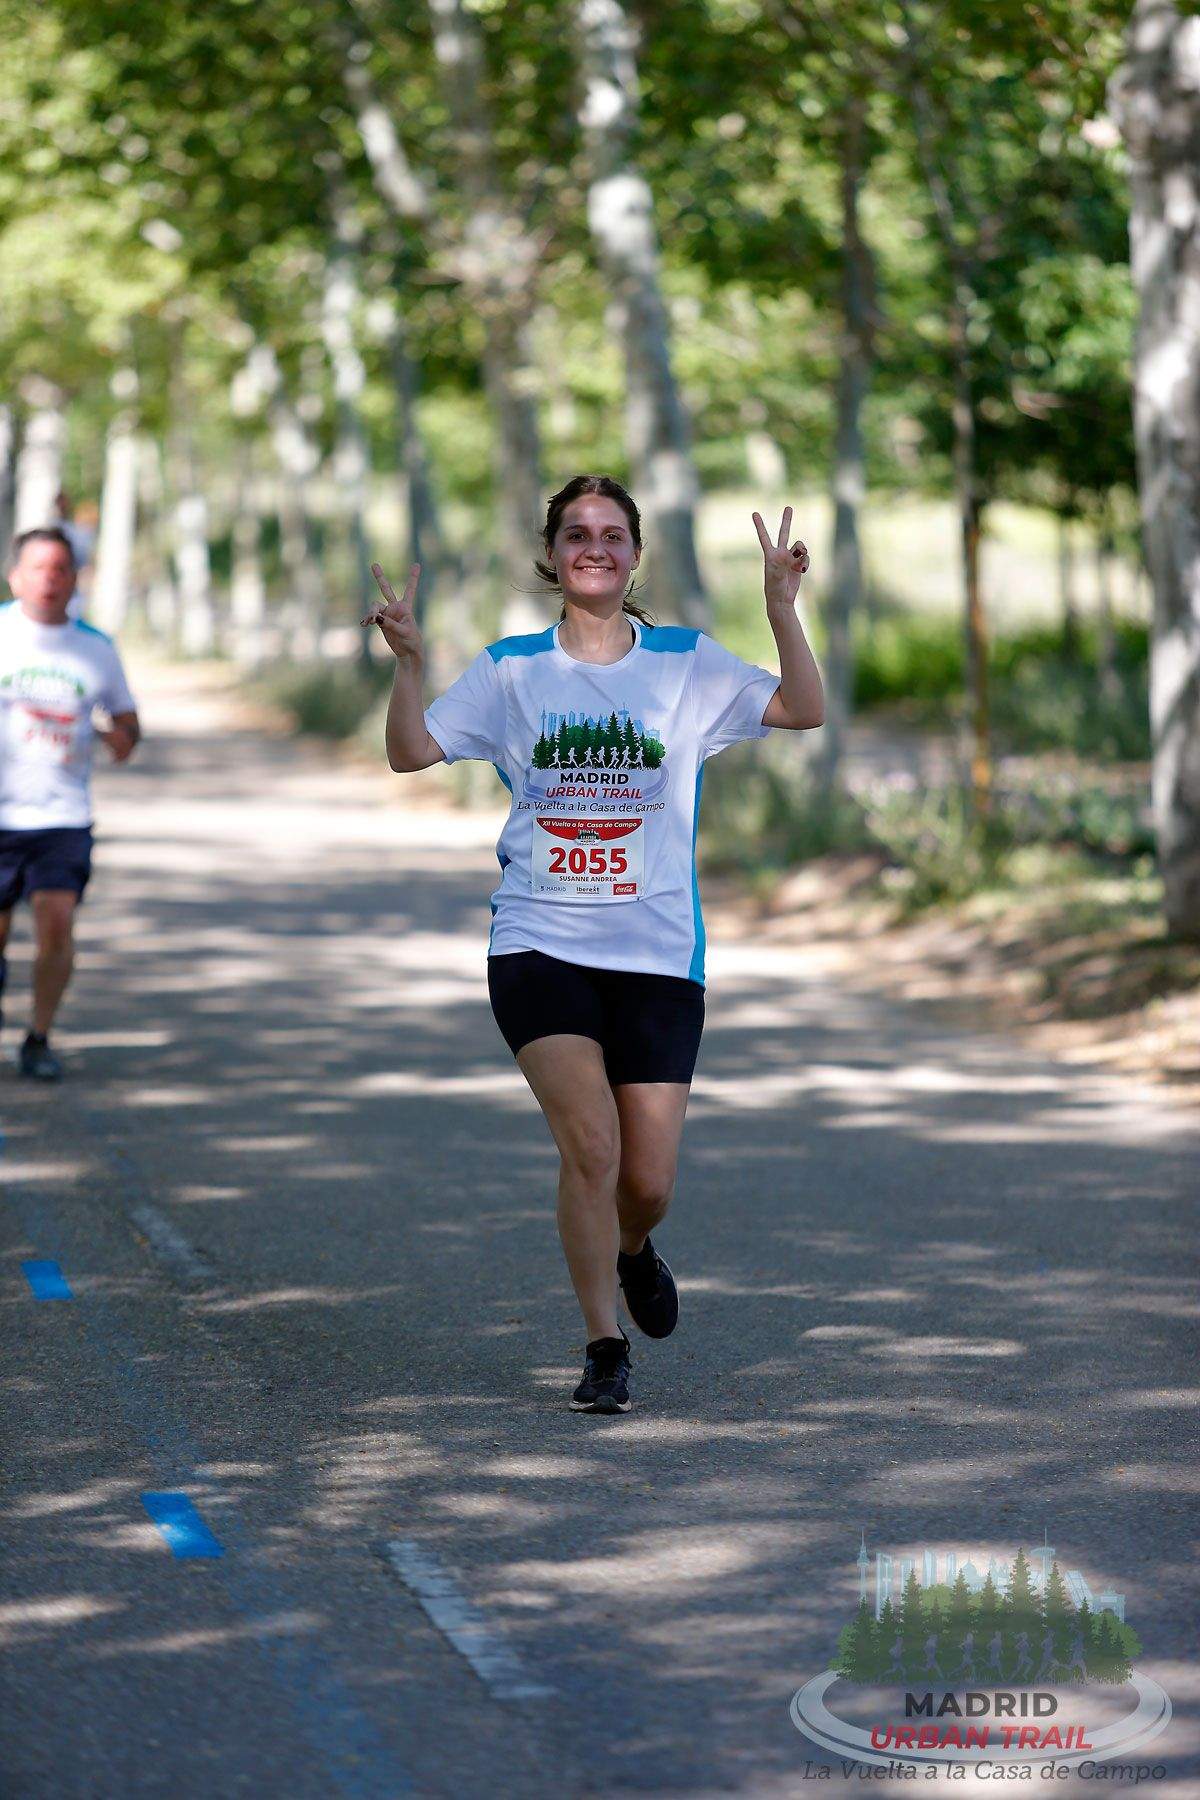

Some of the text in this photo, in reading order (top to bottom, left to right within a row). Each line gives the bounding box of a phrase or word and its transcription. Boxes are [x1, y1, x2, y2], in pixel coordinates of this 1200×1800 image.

[560, 773, 629, 784] MADRID
[546, 787, 642, 799] URBAN TRAIL
[517, 801, 665, 814] La Vuelta a la Casa de Campo
[548, 847, 628, 874] 2055
